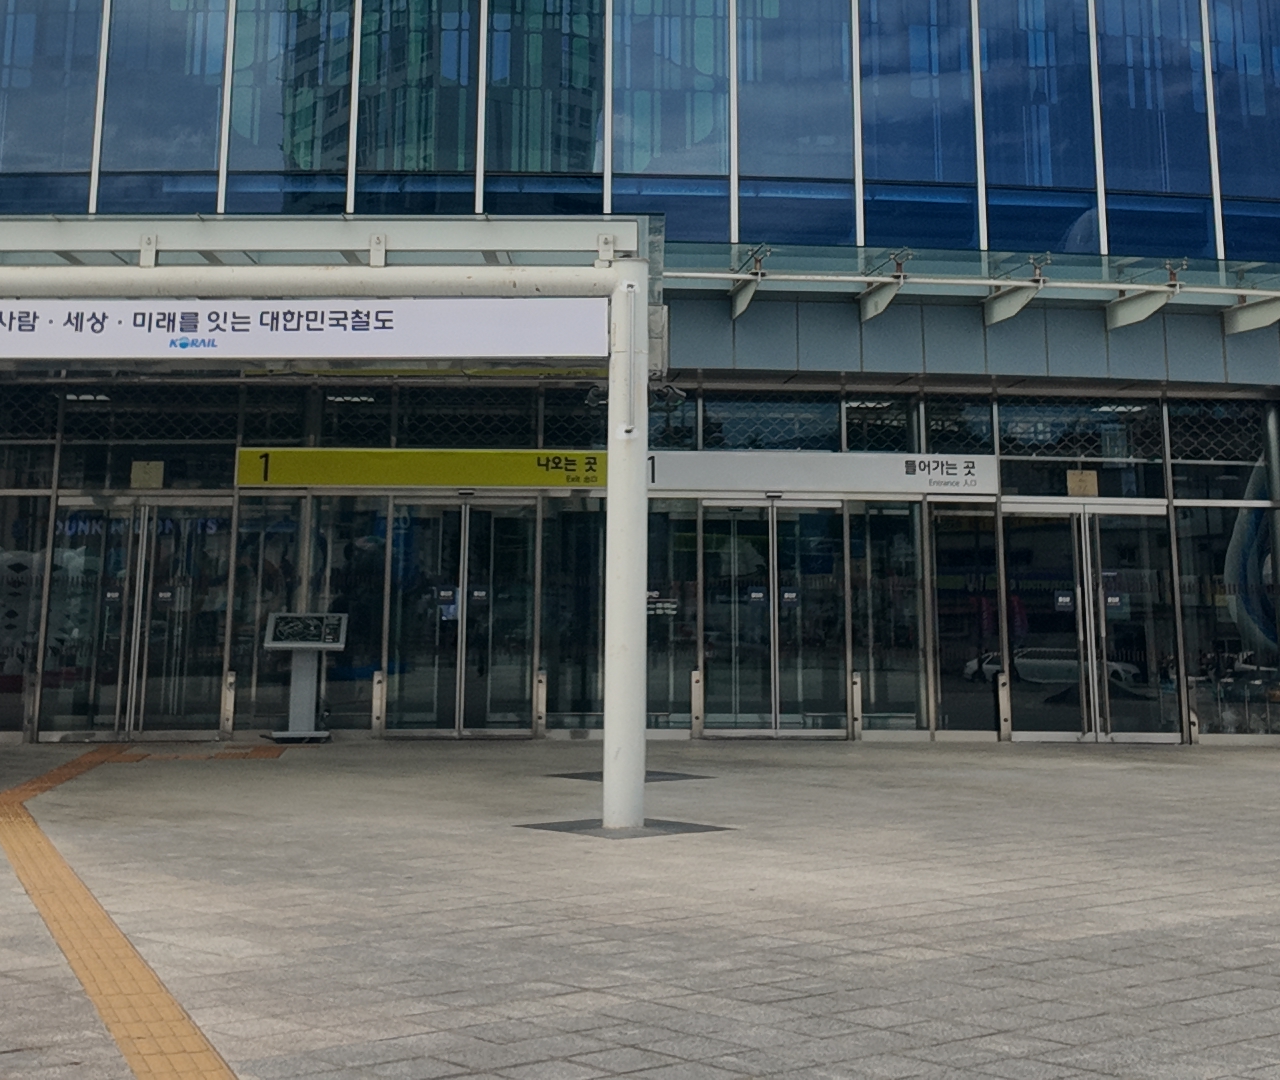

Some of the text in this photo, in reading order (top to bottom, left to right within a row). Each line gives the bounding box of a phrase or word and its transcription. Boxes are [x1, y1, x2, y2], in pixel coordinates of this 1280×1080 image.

[62, 310, 109, 334] 세상
[132, 310, 200, 334] 미래를
[207, 310, 252, 334] 잇는
[258, 309, 395, 333] 대한민국철도
[169, 336, 218, 349] KORAIL
[258, 452, 270, 482] 1
[536, 456, 598, 473] 나오는 곳
[647, 455, 656, 483] 1
[904, 459, 976, 477] 들어가는 곳
[566, 475, 580, 483] Exit
[928, 478, 960, 487] Entrance
